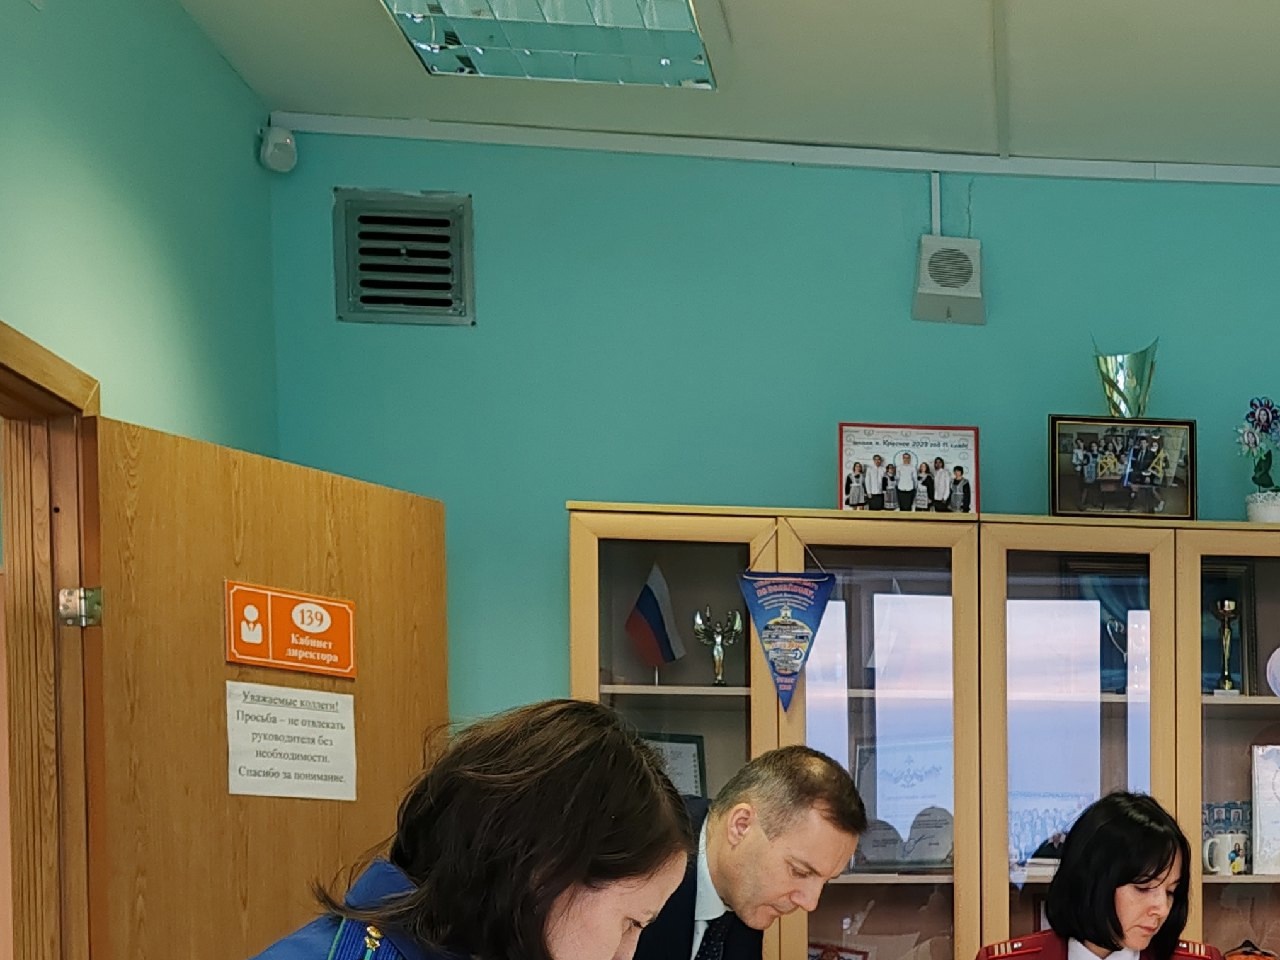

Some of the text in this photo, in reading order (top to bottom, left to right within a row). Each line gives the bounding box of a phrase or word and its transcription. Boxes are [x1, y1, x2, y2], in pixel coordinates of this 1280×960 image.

[299, 608, 324, 627] 139
[291, 633, 333, 650] Кабинет
[286, 647, 339, 663] директора
[242, 690, 339, 712] Уважаемые коллеги!
[236, 710, 345, 730] Просьба не отвлекать
[251, 732, 333, 749] руководителя без
[255, 749, 330, 764] необходимости.
[238, 766, 346, 784] Спасибо за понимание.
